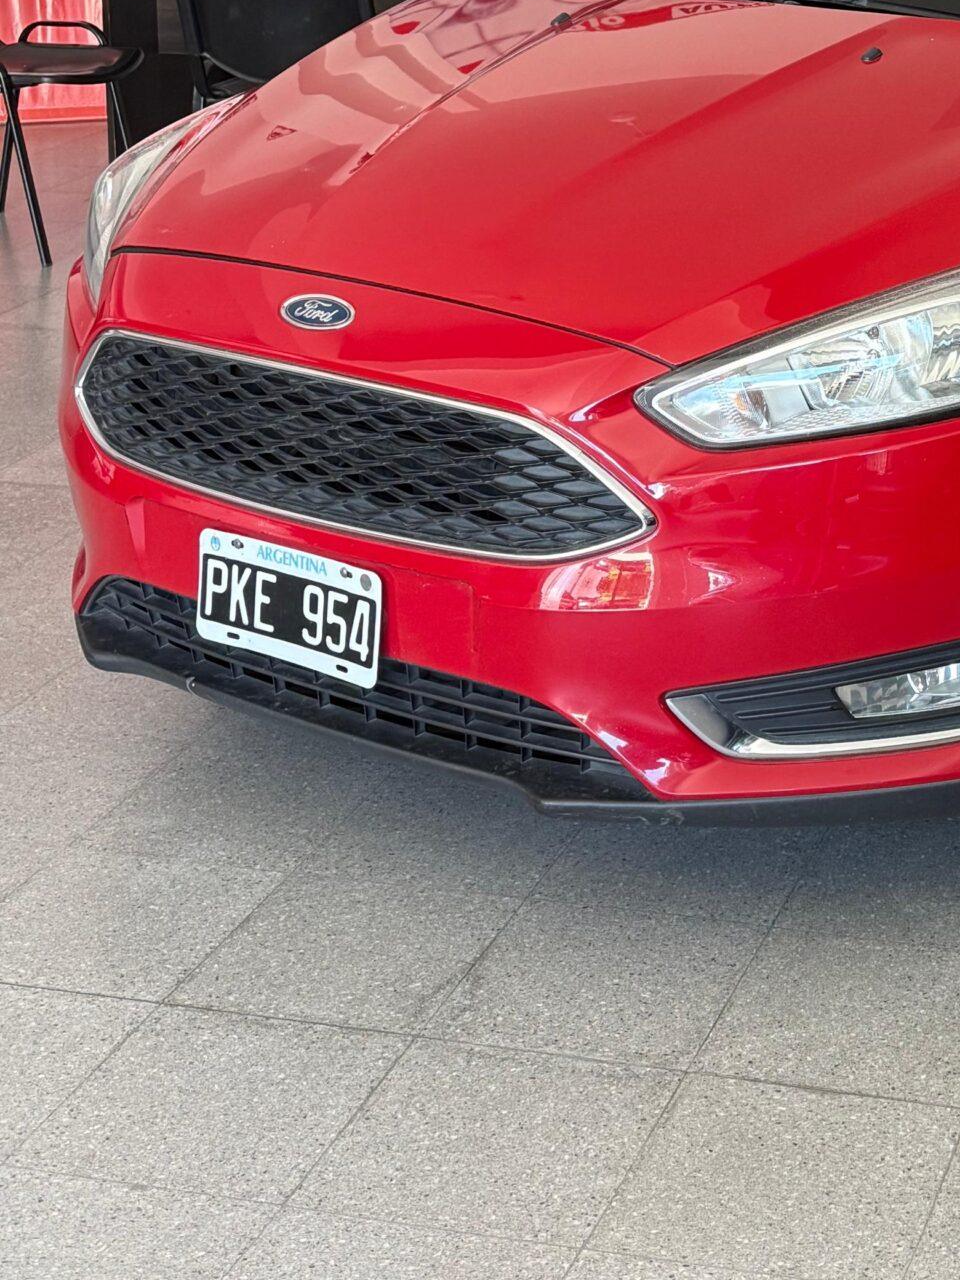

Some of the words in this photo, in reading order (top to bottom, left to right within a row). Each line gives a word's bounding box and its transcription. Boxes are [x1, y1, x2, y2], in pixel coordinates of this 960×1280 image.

[294, 299, 339, 322] Ford
[256, 545, 328, 577] ARGENTINA
[204, 558, 278, 633] PKE
[301, 584, 371, 662] 954
